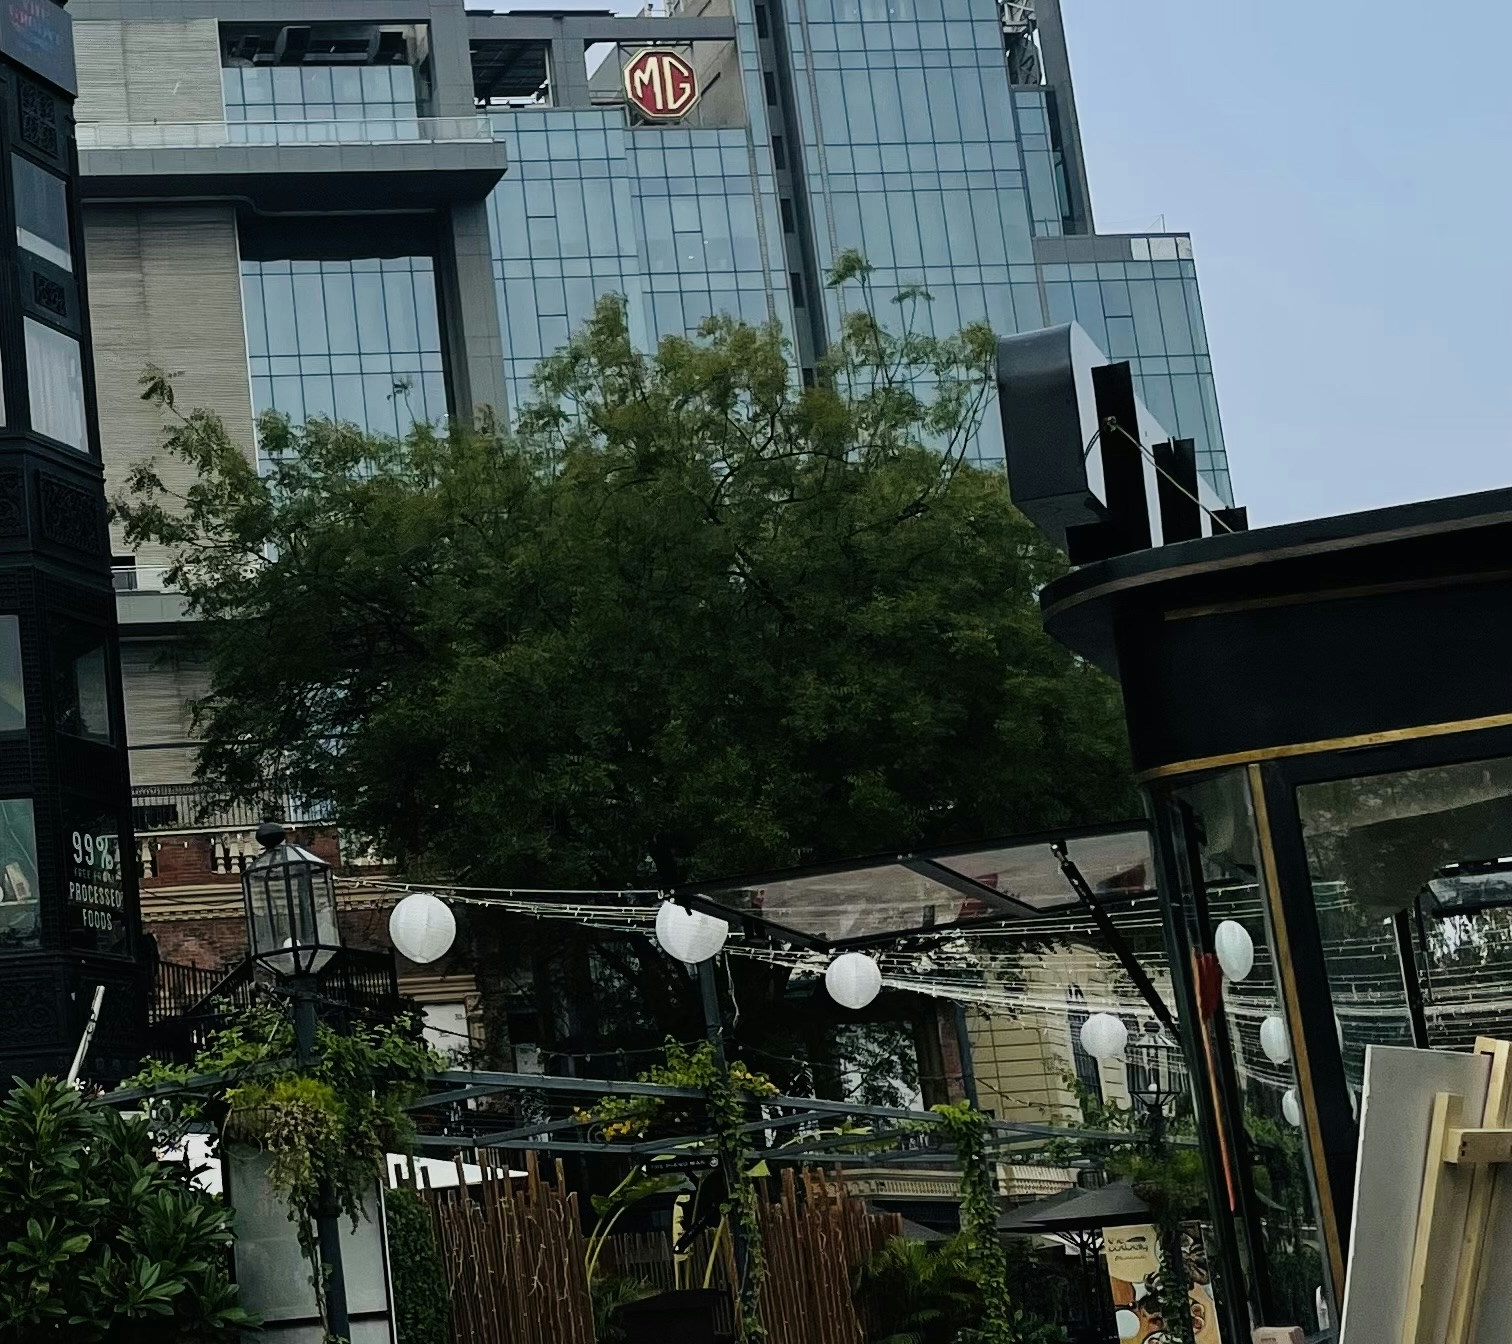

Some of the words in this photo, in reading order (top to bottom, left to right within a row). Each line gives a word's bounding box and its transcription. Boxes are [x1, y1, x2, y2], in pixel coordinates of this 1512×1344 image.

[633, 56, 691, 110] MG
[72, 831, 114, 870] 99%
[69, 881, 123, 908] PROCESSED
[82, 908, 113, 931] FOODS
